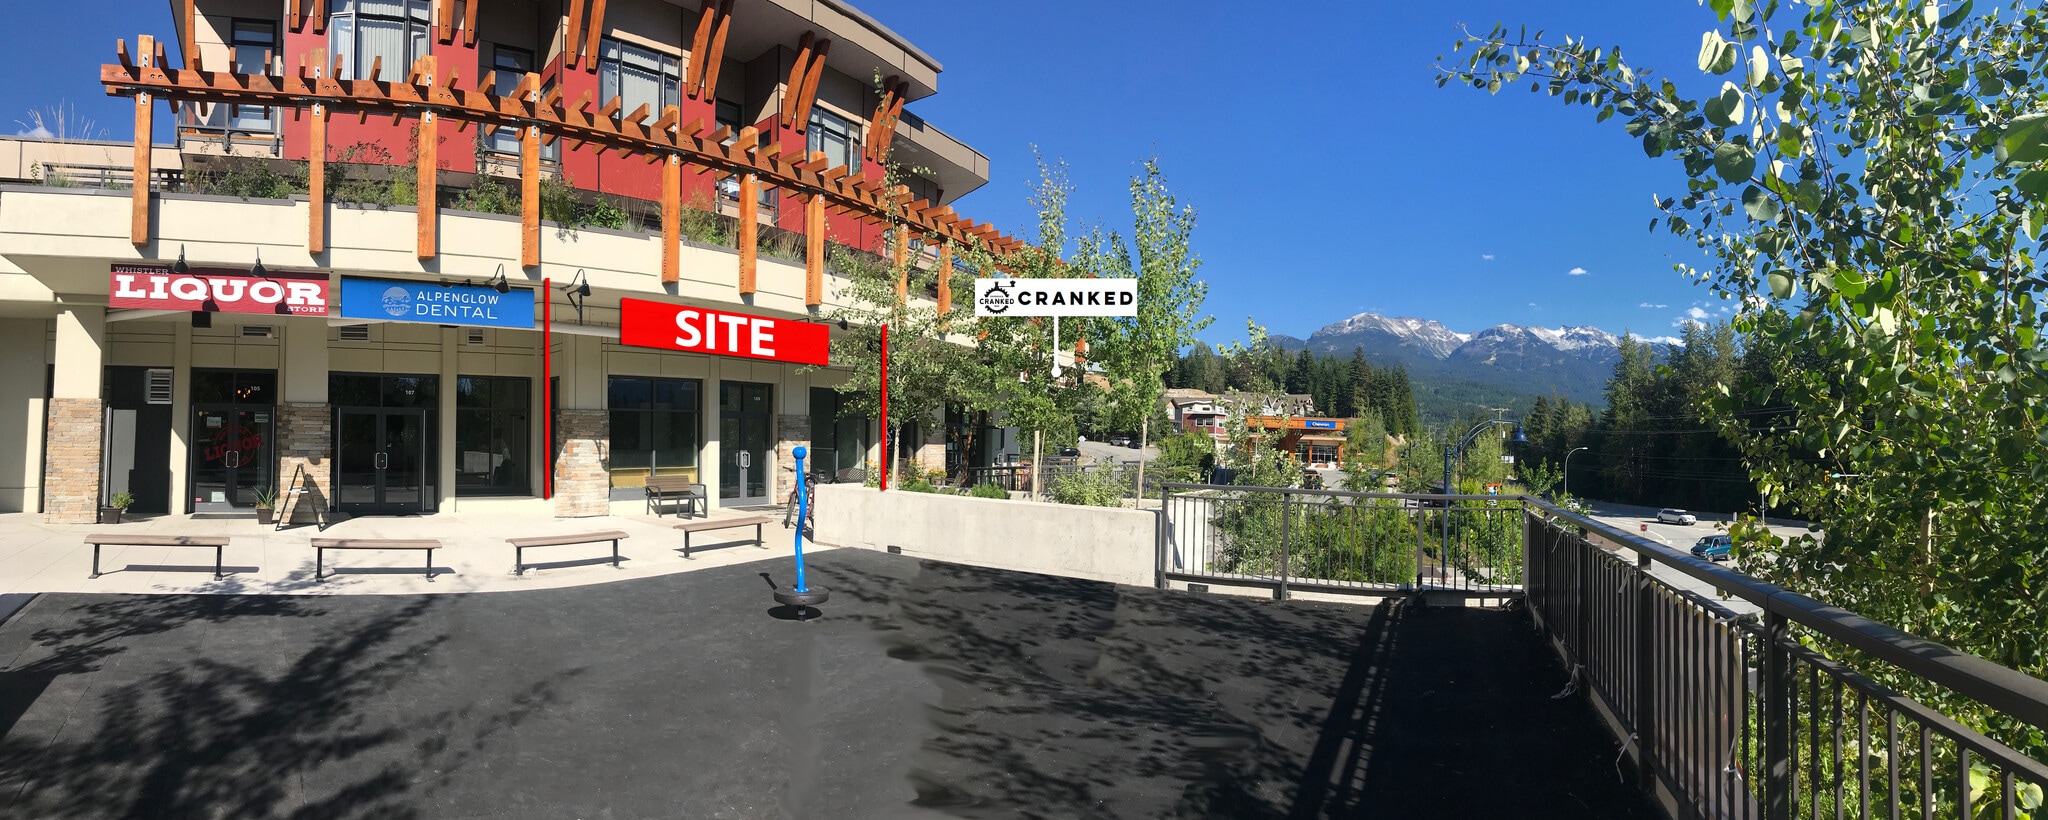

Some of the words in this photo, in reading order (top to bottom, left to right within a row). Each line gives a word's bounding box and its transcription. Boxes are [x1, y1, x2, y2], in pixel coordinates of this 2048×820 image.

[115, 266, 169, 275] WHISTLER
[115, 274, 325, 306] LIQUOR
[417, 291, 500, 305] ALPENGLOW
[416, 304, 498, 320] DENTAL
